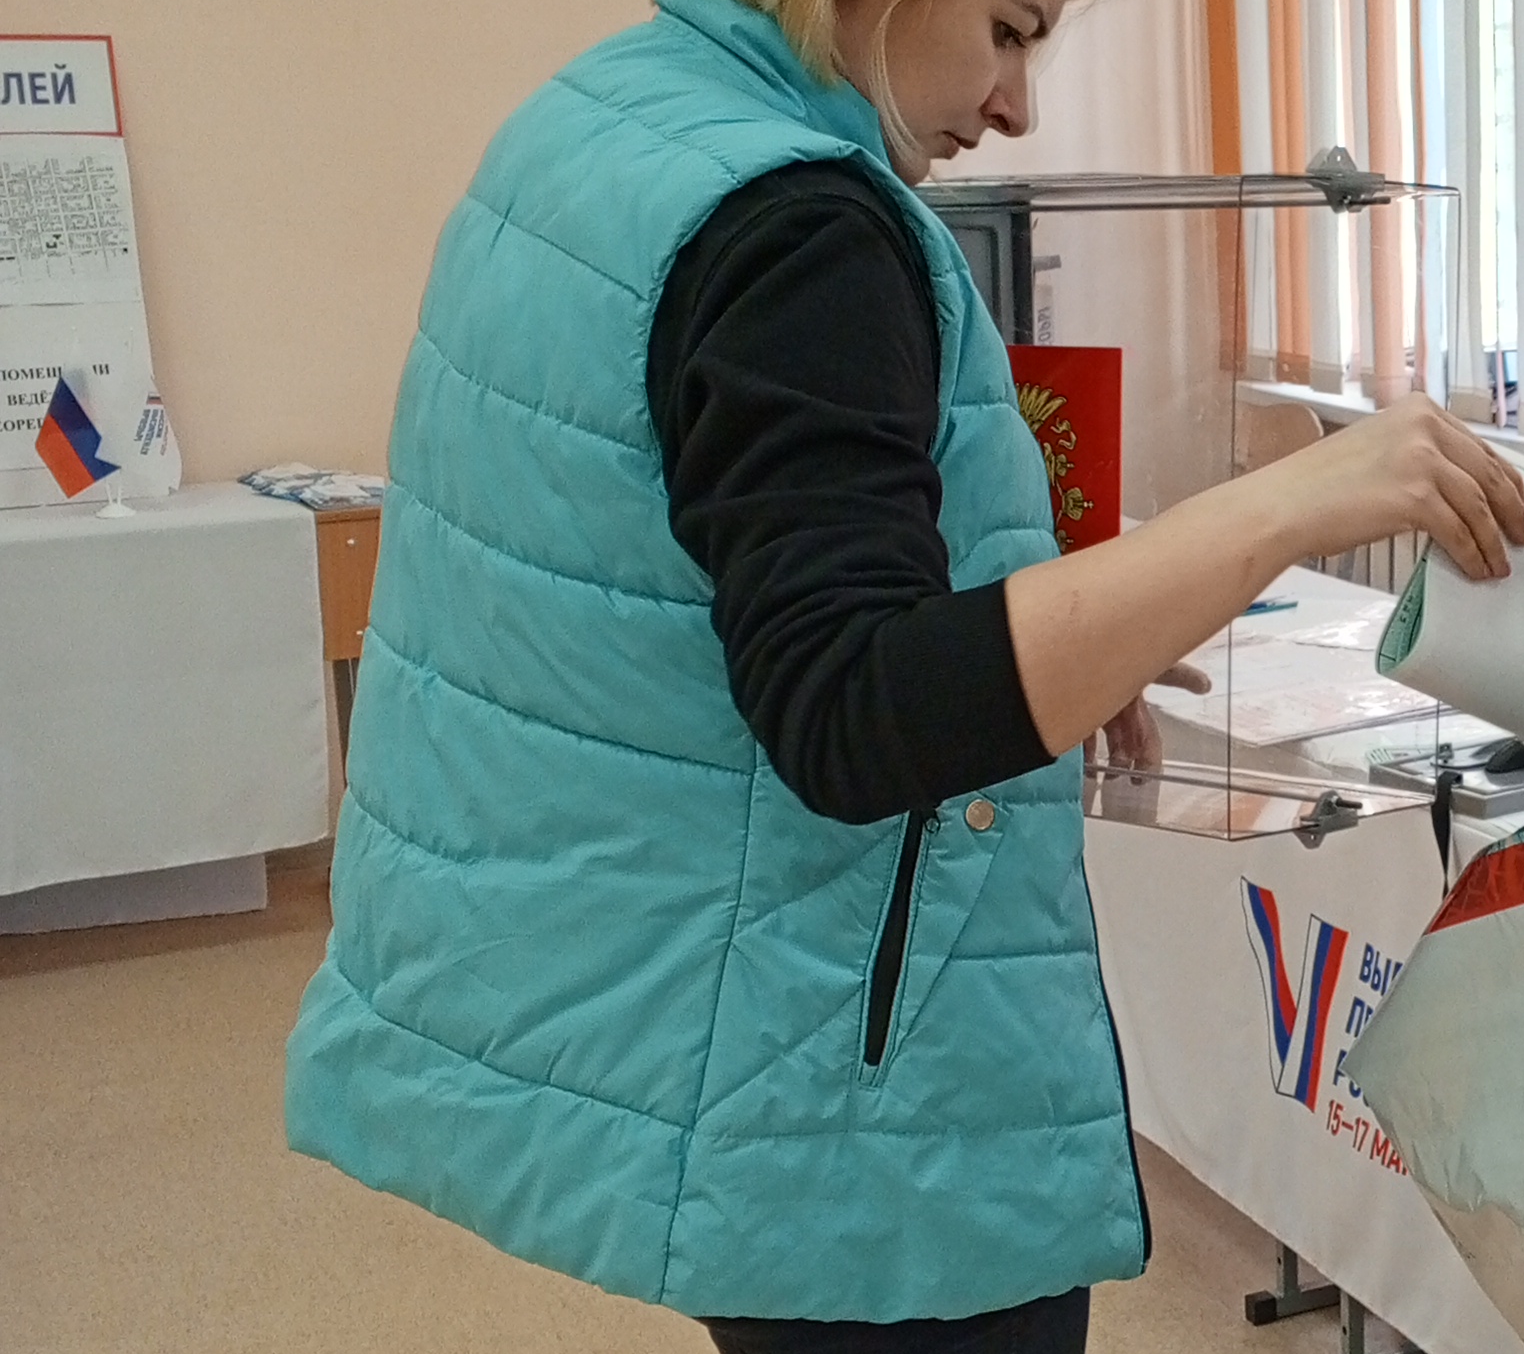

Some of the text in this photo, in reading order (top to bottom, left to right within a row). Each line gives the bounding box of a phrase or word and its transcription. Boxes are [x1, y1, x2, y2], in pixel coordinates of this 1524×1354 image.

[1, 64, 76, 104] ЛЕЙ
[7, 390, 53, 407] ВЕДЁ
[1370, 1128, 1408, 1176] МА
